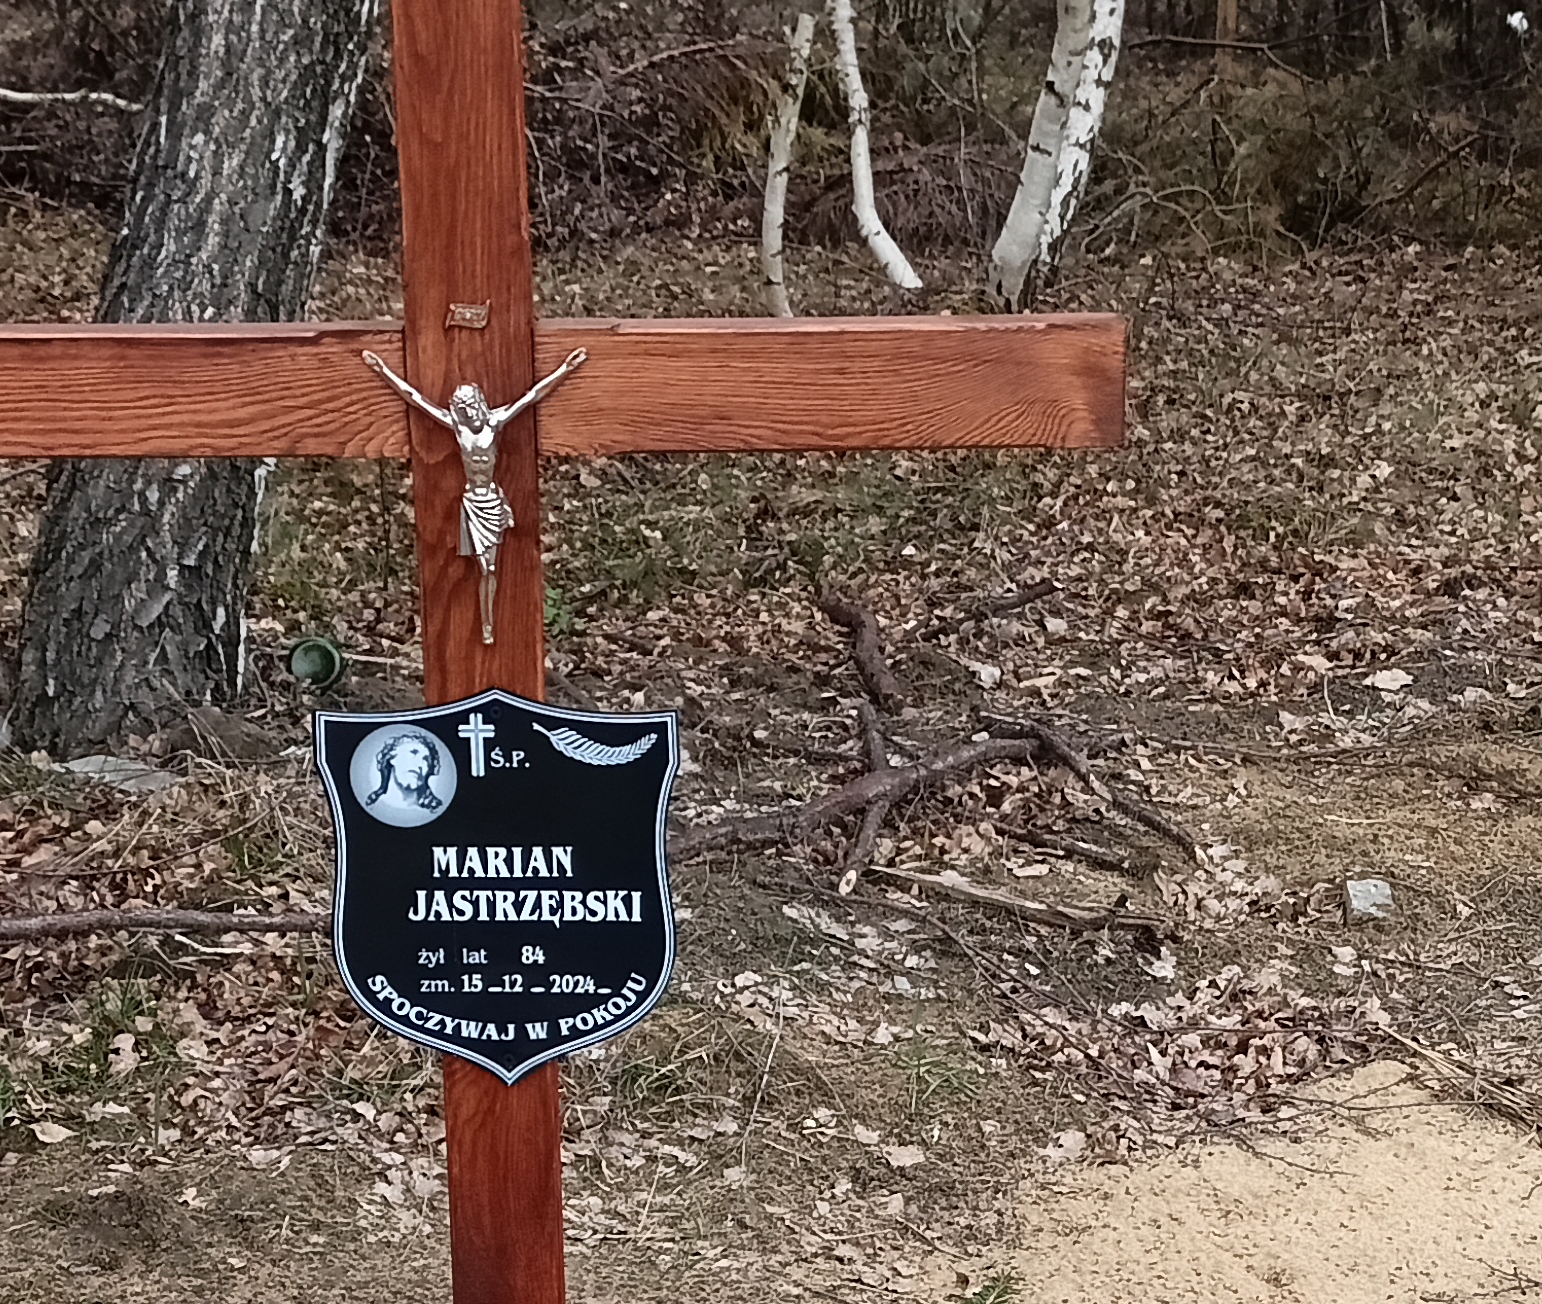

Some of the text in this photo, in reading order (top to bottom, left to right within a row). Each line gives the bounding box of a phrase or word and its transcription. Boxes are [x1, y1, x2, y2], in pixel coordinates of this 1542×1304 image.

[490, 747, 530, 768] Ś.P.
[432, 846, 574, 878] MARIAN
[408, 890, 642, 929] JASTRZĘBSKI
[418, 945, 545, 967] żył lat 84
[420, 979, 455, 992] zm.
[367, 972, 647, 1041] SPOCZYWAJ W POKOJU
